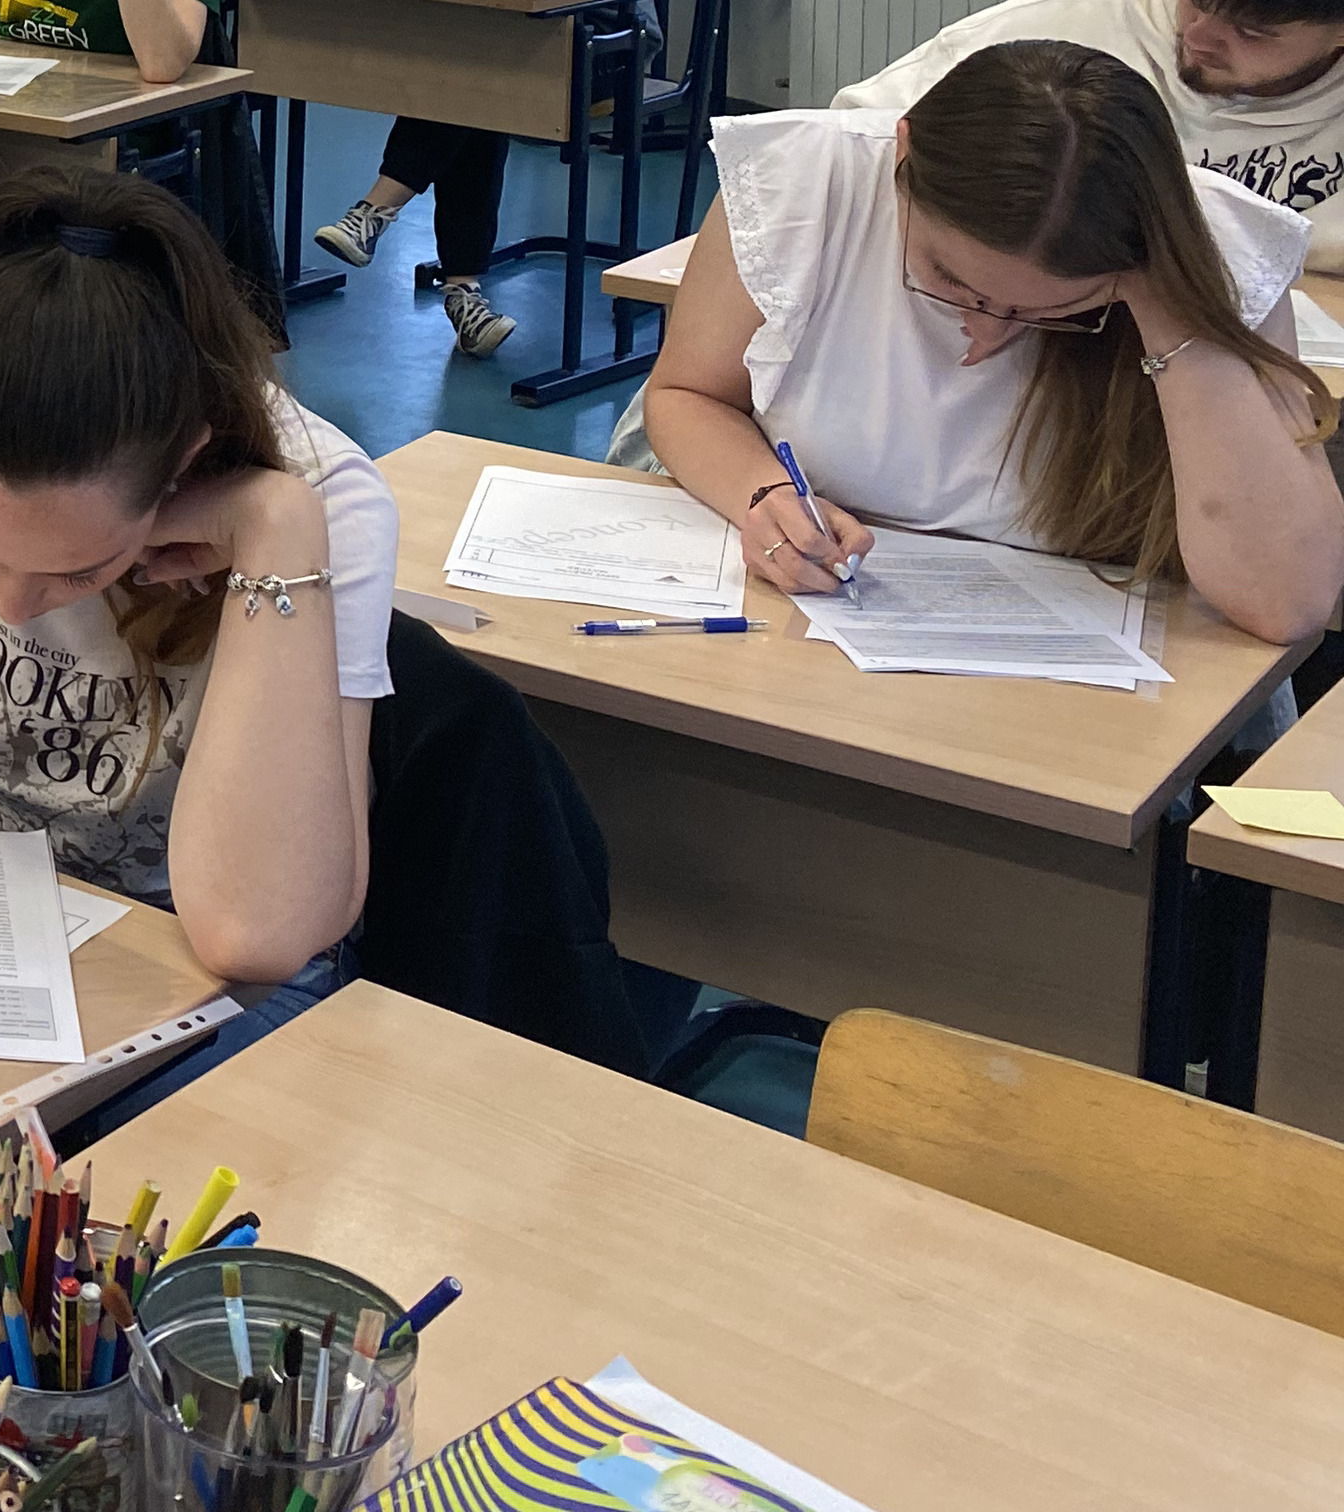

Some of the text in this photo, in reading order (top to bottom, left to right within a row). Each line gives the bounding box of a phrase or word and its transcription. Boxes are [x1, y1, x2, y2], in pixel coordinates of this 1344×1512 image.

[8, 19, 89, 50] GREEN
[23, 637, 50, 659] the
[50, 643, 81, 668] city
